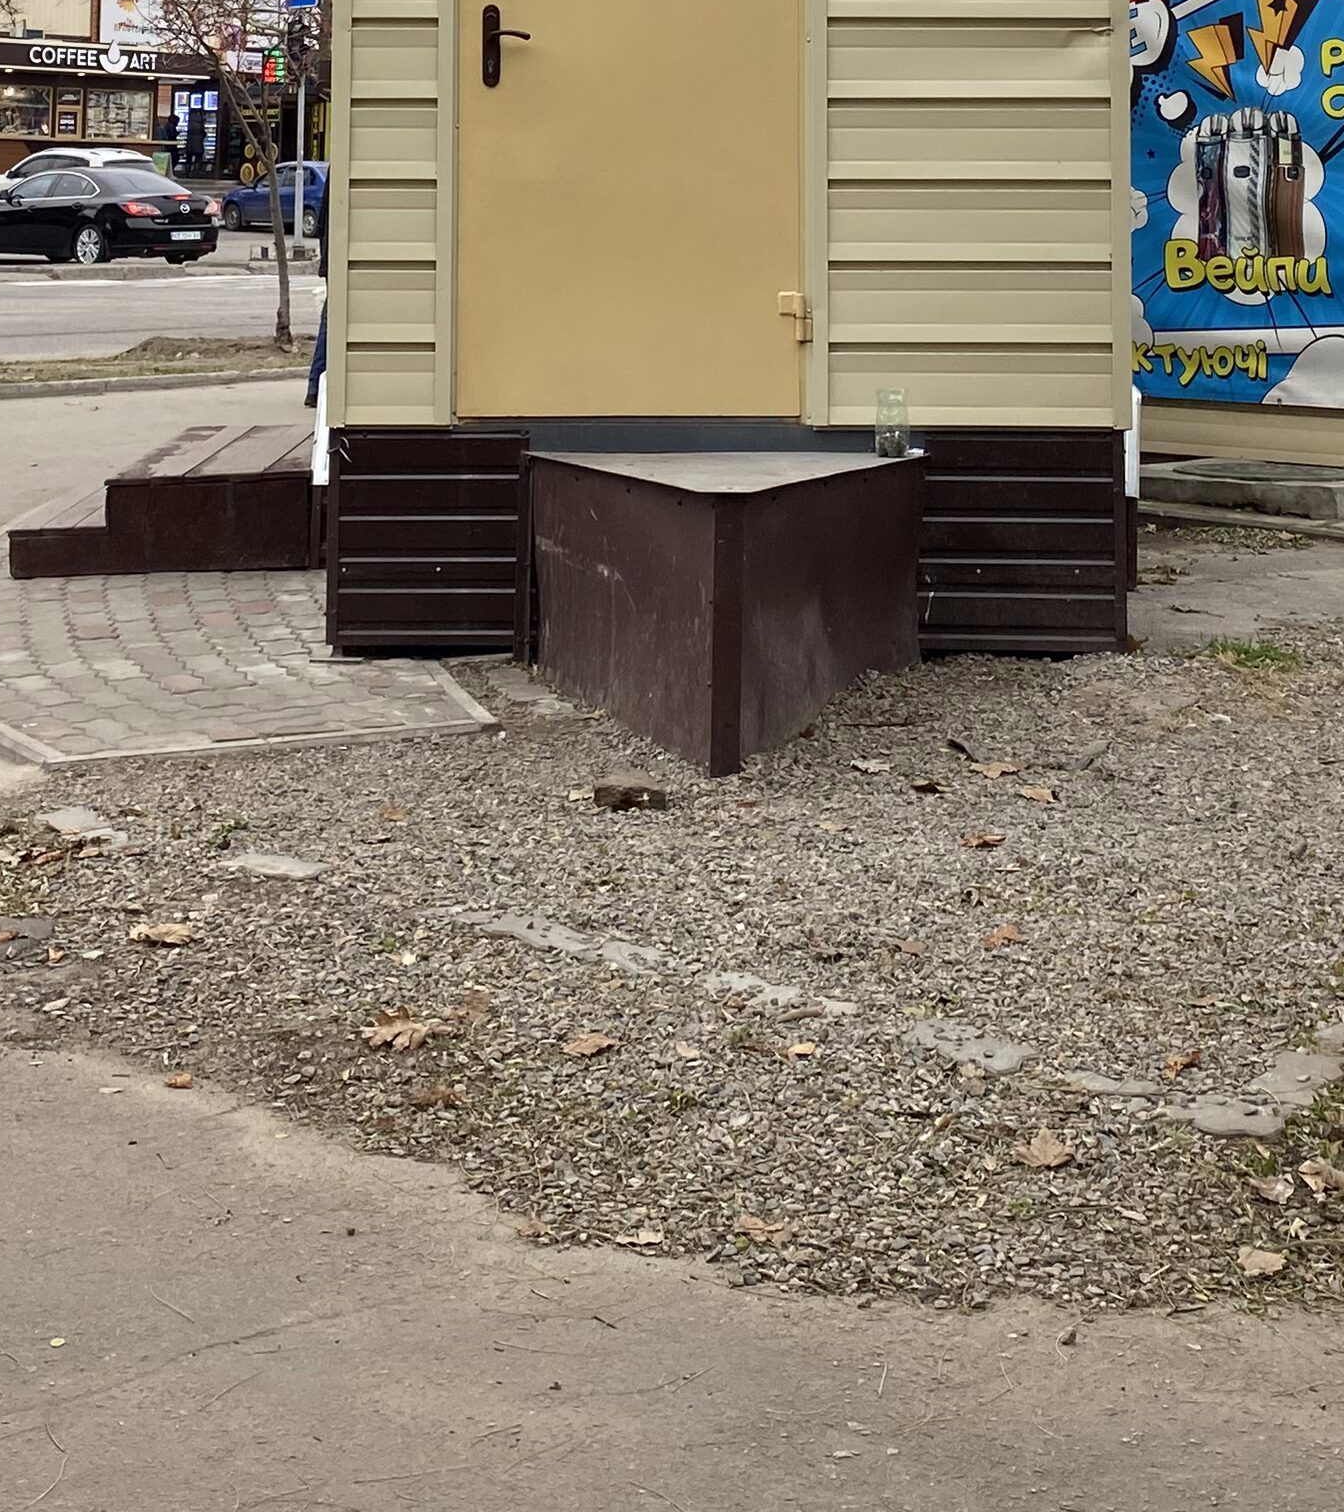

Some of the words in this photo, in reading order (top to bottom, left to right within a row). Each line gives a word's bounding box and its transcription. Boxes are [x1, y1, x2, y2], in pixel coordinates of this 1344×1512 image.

[29, 46, 98, 67] COFFEE
[129, 53, 158, 71] ART
[1164, 238, 1331, 295] Вейпи
